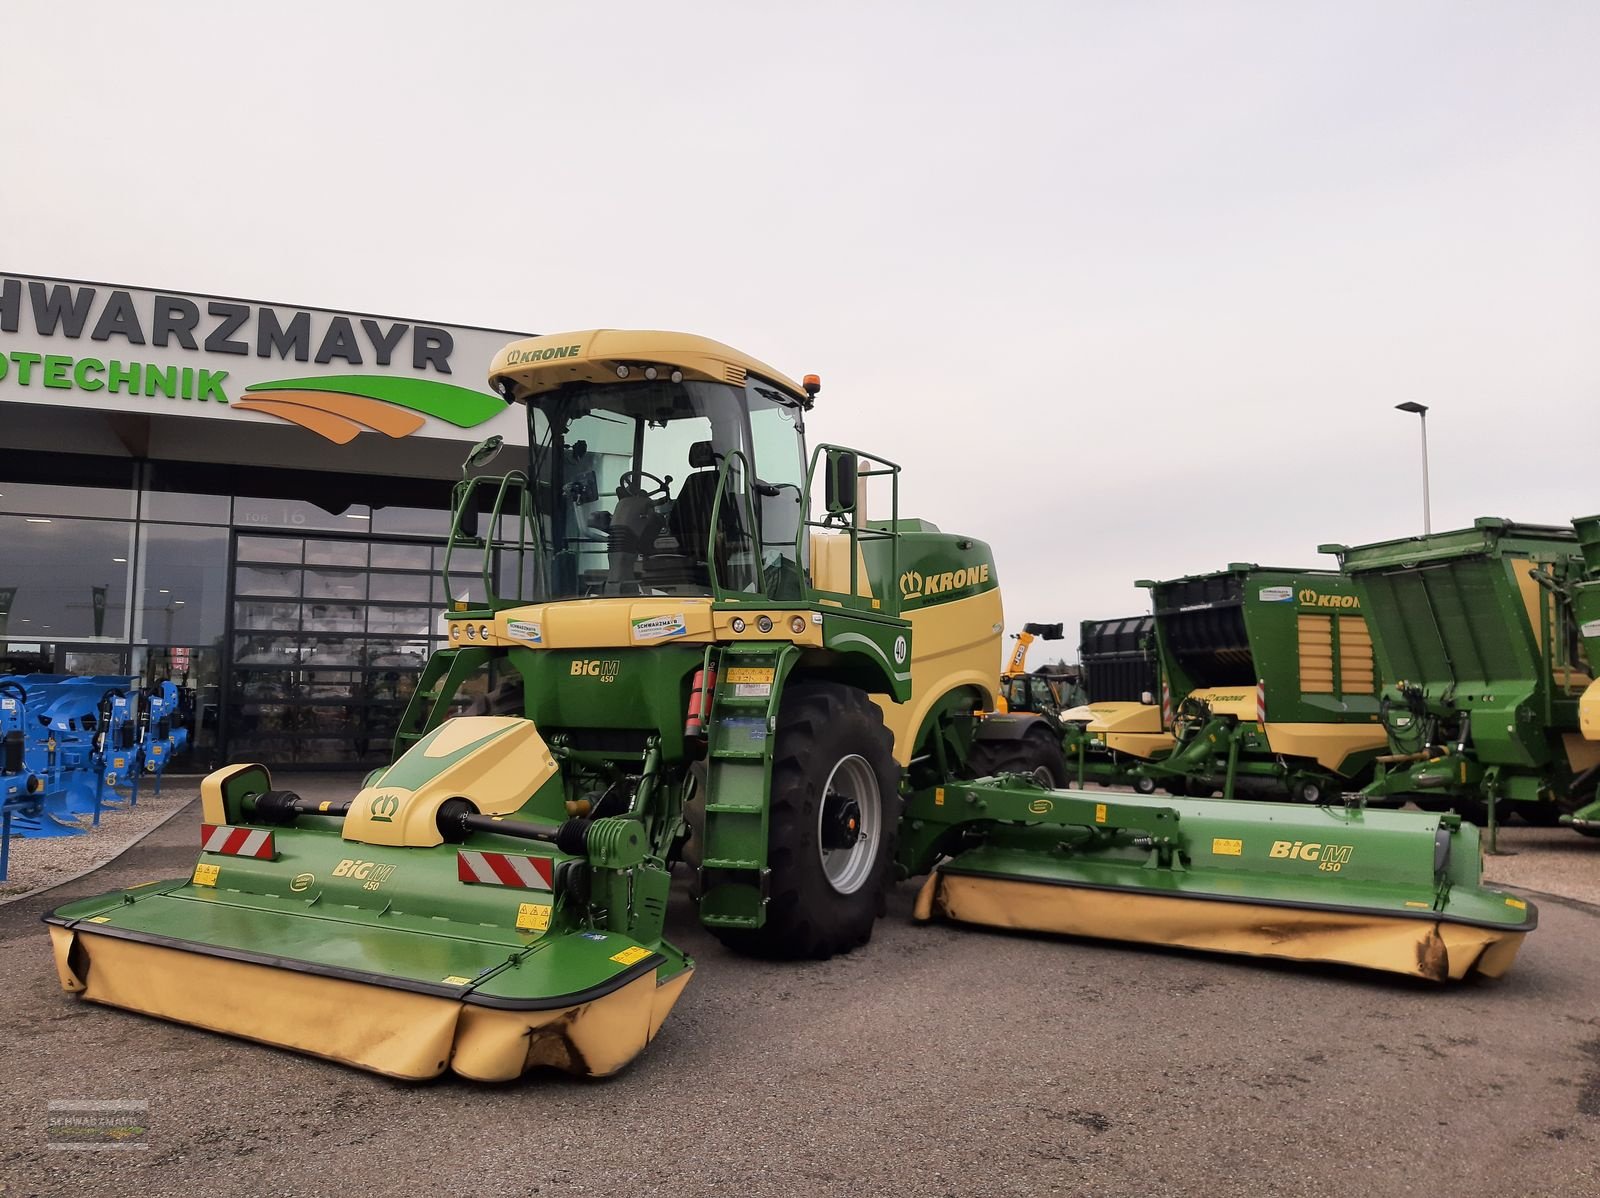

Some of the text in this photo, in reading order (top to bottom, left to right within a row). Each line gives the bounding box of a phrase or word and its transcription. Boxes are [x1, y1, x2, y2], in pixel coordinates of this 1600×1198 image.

[520, 345, 581, 363] KRONE
[0, 351, 229, 403] TECHNIK
[282, 508, 306, 525] 16
[925, 564, 988, 594] KRONE
[896, 640, 905, 659] 40
[1015, 645, 1026, 665] JCB
[600, 675, 614, 683] 450
[1319, 862, 1341, 871] 450
[363, 882, 379, 890] 450
